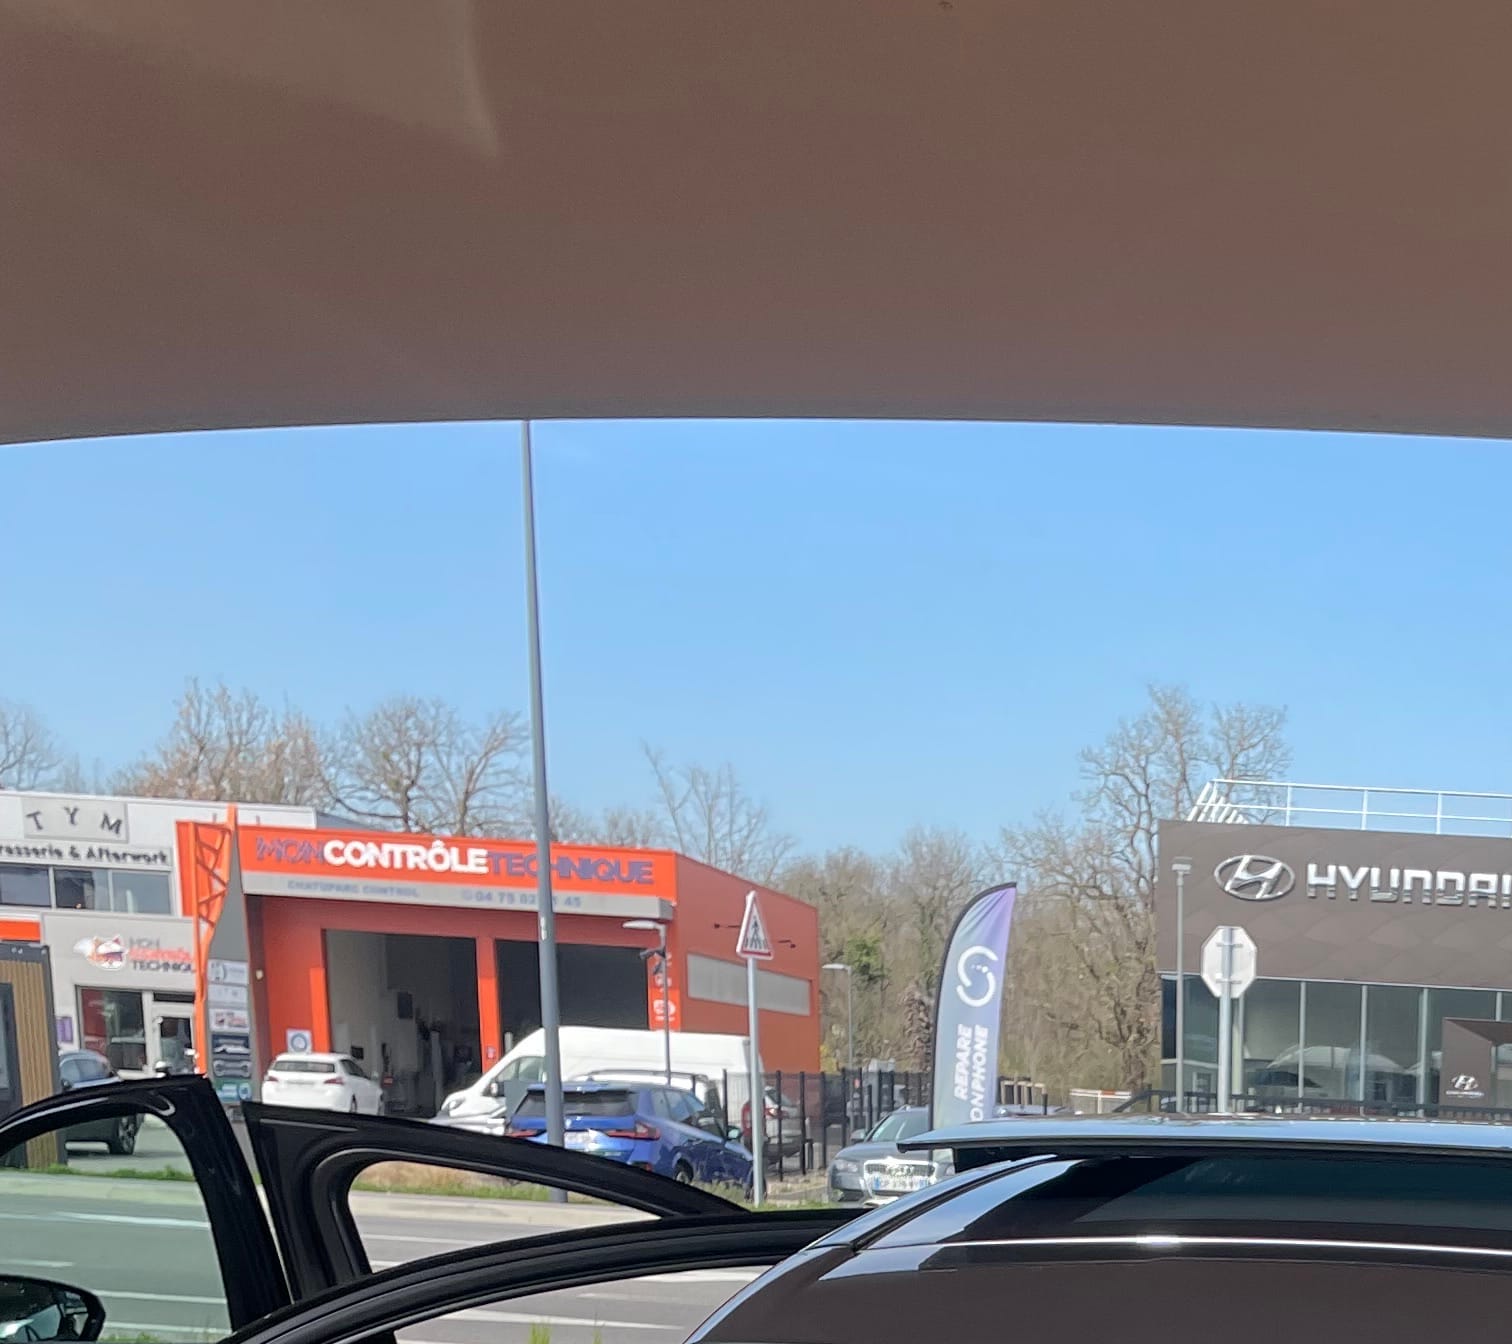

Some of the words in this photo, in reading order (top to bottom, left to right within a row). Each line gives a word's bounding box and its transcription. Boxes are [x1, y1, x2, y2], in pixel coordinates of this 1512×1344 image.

[0, 844, 63, 859] rasserie
[323, 840, 489, 875] CONTRÔLE
[1307, 864, 1512, 908] HYUNDAI
[969, 1024, 988, 1122] ONPHONE
